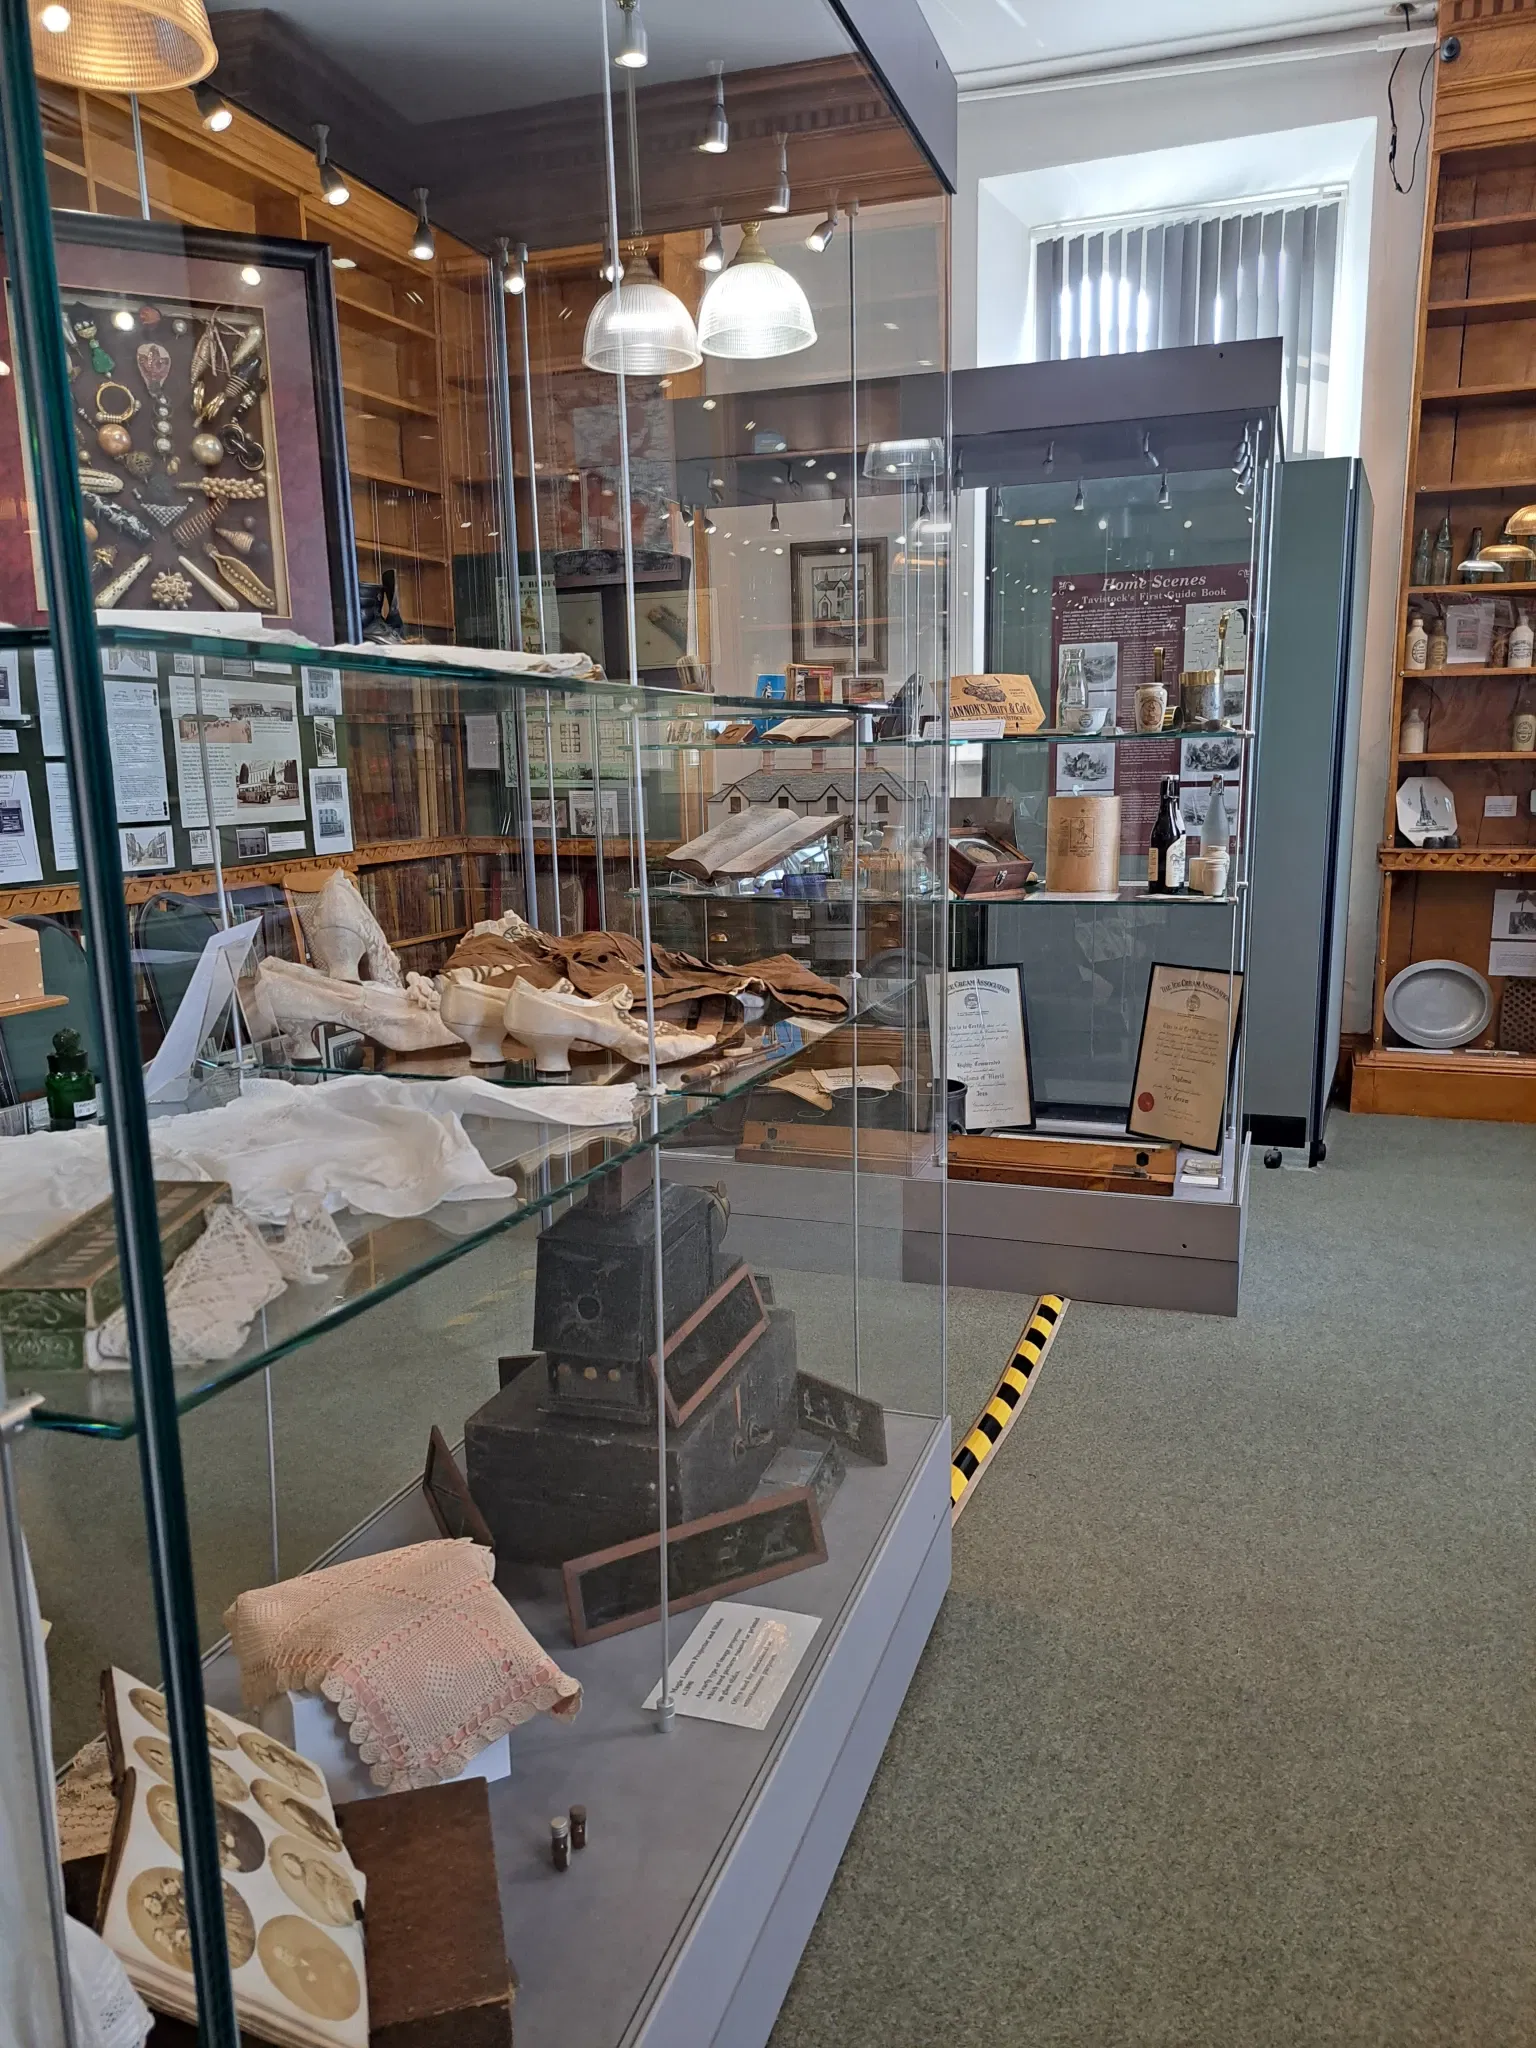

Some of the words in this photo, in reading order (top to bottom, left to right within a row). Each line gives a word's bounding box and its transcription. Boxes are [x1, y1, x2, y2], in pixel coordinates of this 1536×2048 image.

[1102, 577, 1147, 592] Home
[1152, 574, 1206, 588] Scenes
[1082, 594, 1134, 604] Tavistock's
[1140, 592, 1162, 600] First
[1168, 590, 1196, 599] Guide
[1202, 588, 1226, 596] Book
[989, 704, 1008, 714] Dairy
[1009, 703, 1014, 714] &
[954, 980, 975, 988] CREAM
[977, 978, 1011, 994] ASSOCIATION
[1181, 979, 1201, 987] CREAM
[670, 1680, 684, 1693] Magic
[680, 1661, 696, 1679] Lantern
[693, 1640, 710, 1661] Projector
